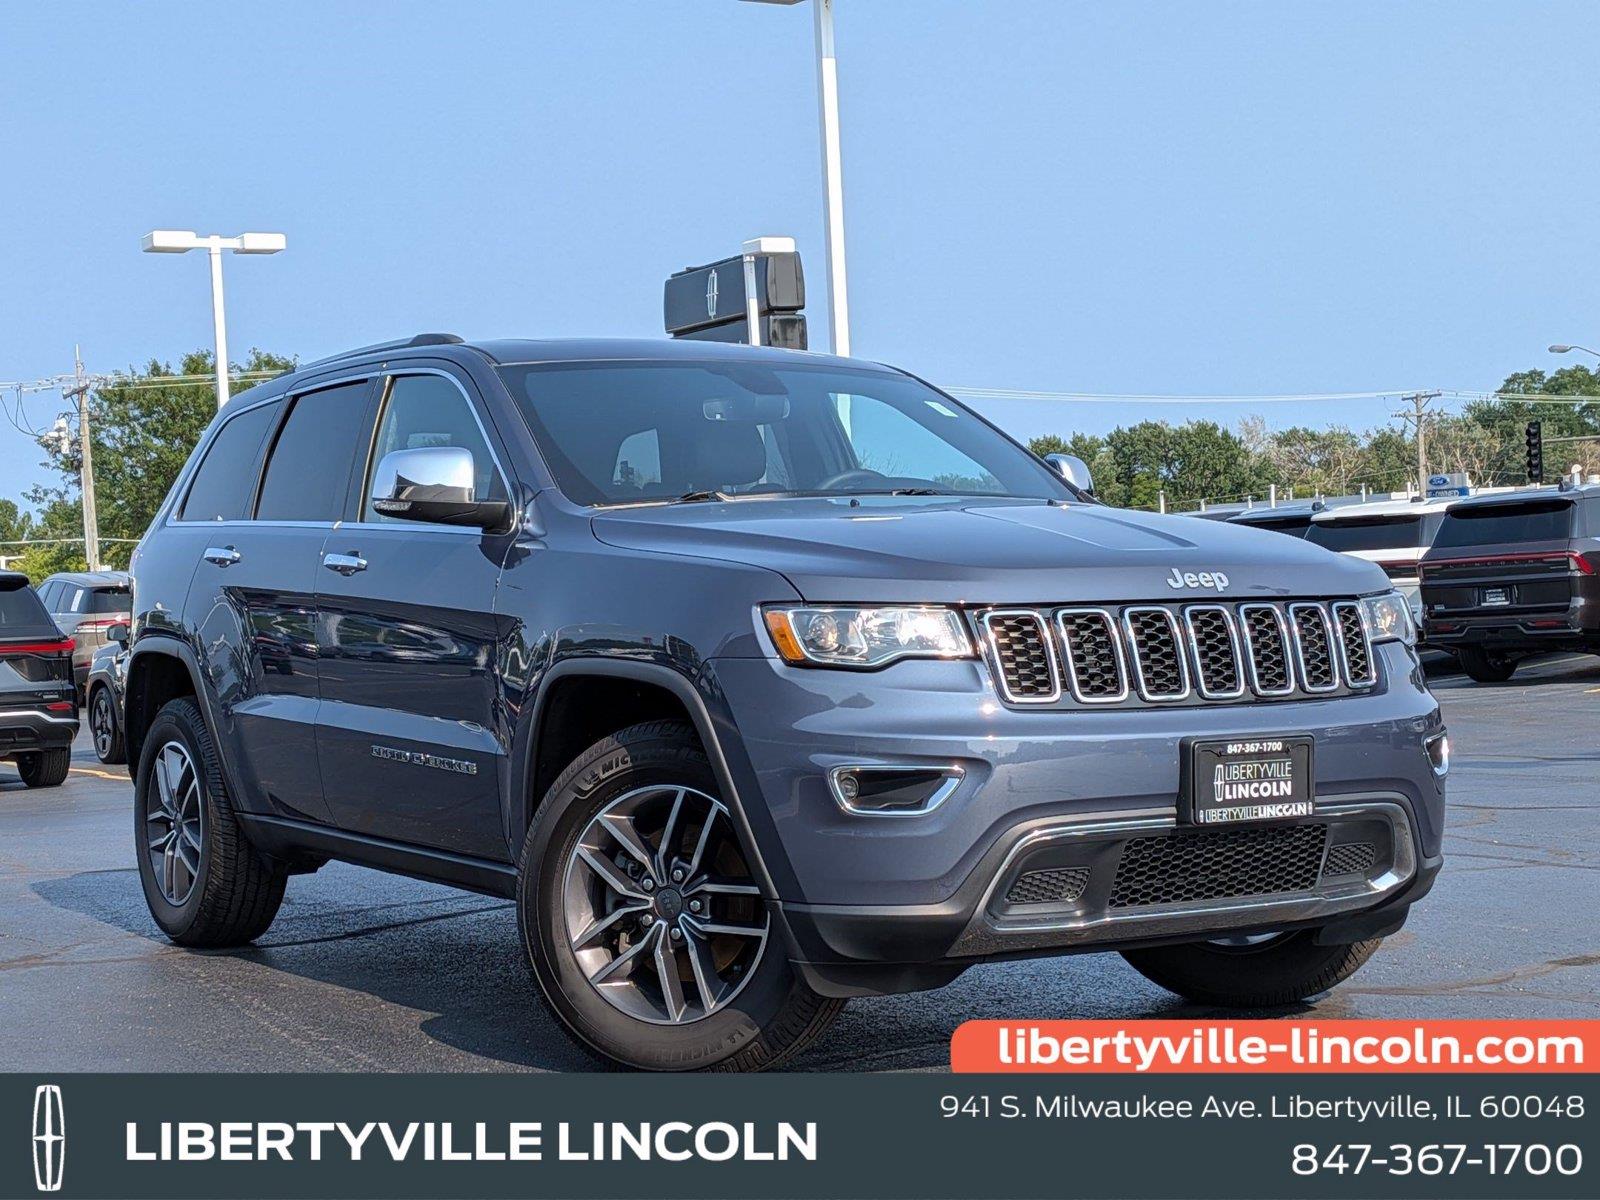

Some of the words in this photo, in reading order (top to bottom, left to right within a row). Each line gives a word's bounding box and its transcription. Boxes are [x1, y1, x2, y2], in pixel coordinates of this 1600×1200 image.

[1167, 568, 1229, 592] Jeep
[1227, 742, 1282, 754] 847-367-1700
[1225, 762, 1291, 780] LIBERTYVILLE
[1225, 781, 1291, 799] LINCOLN
